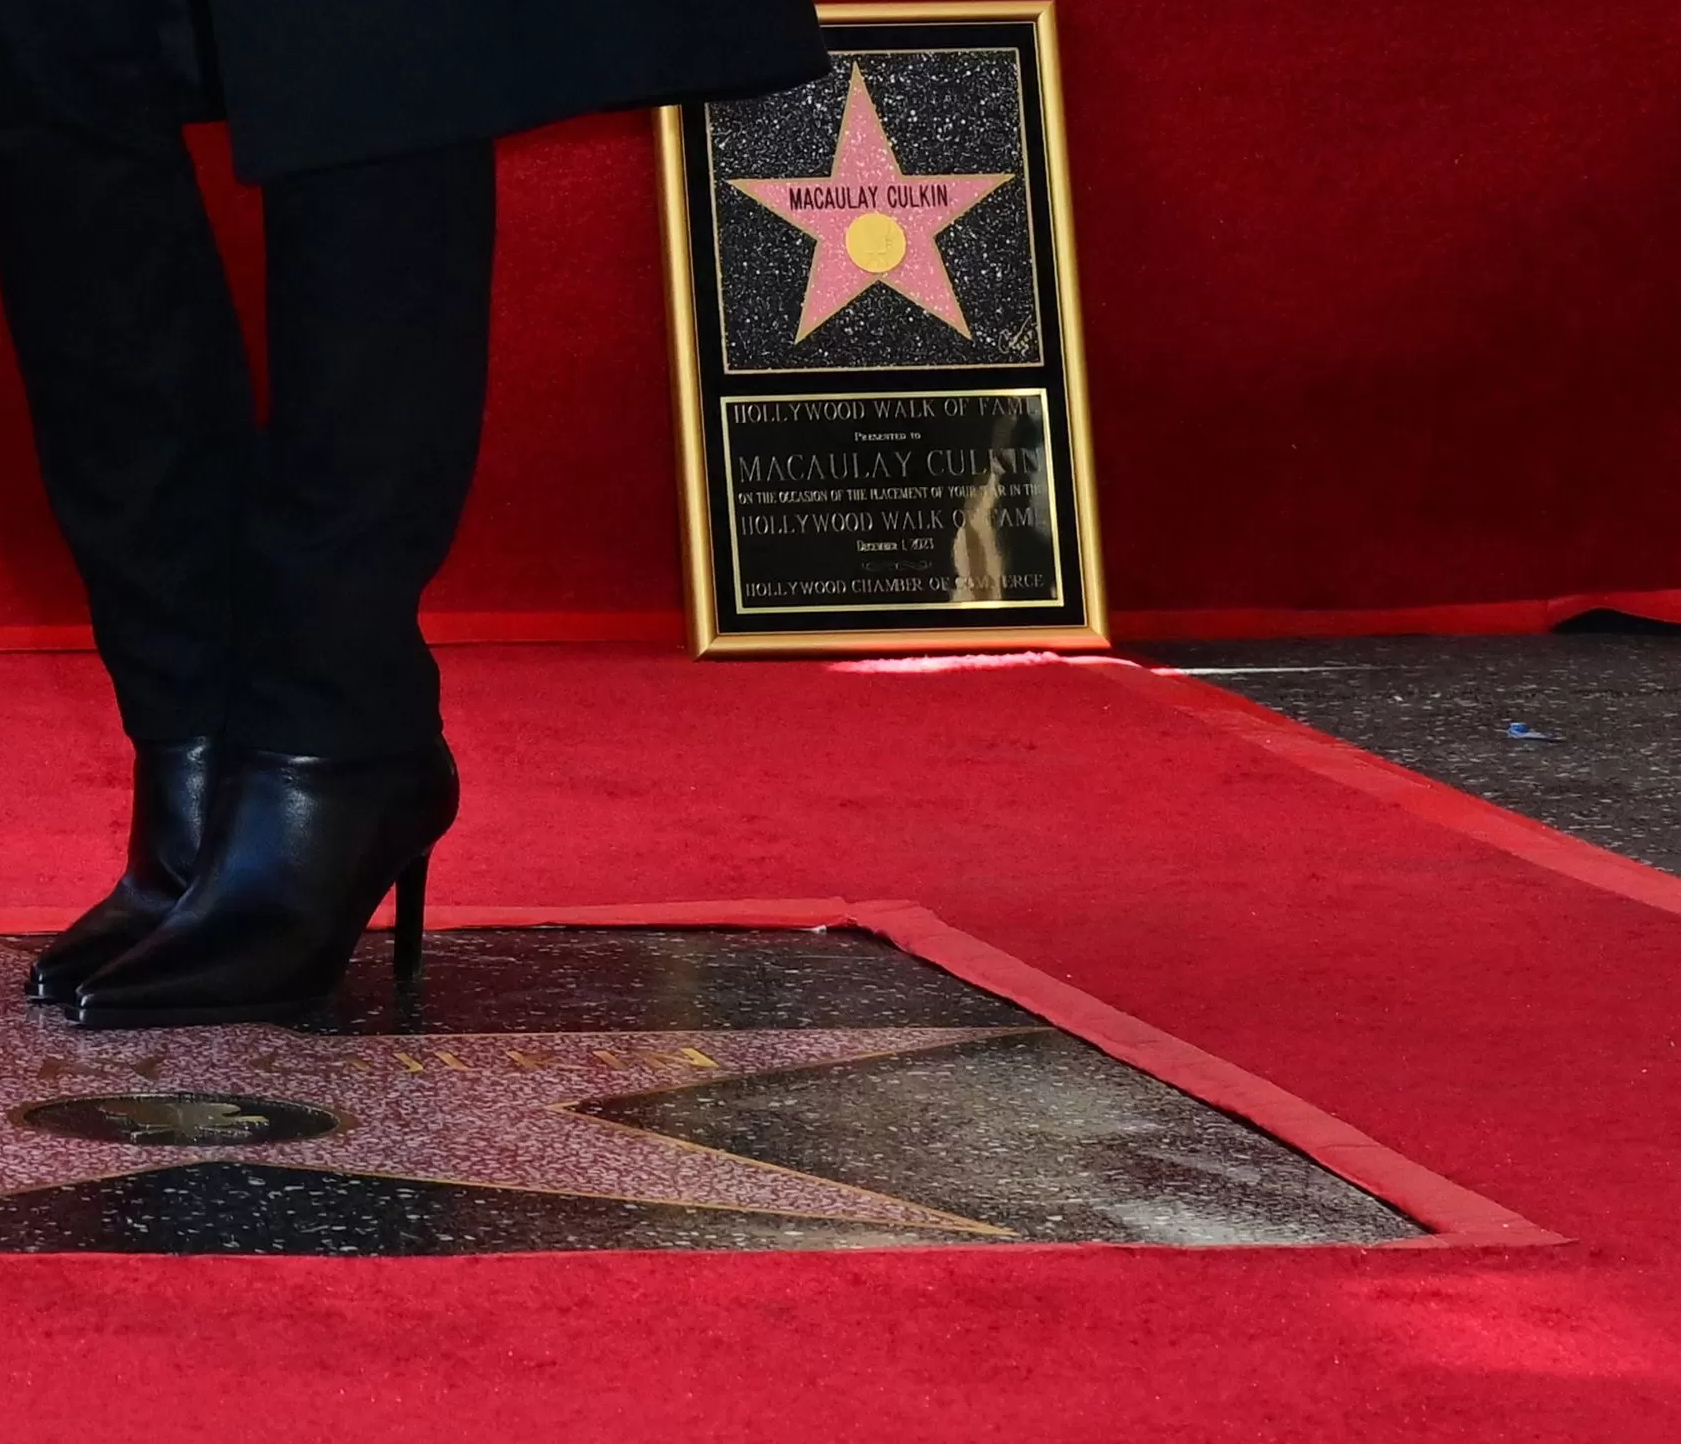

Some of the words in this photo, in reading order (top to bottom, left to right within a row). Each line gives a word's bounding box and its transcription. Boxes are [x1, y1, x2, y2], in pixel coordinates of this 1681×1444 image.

[789, 186, 878, 210] MACAULAY
[887, 184, 949, 208] CULKIN
[734, 401, 865, 423] HOLLYWOOD
[874, 399, 935, 418] WALK
[944, 398, 968, 416] OF
[739, 450, 912, 483] MACAULAY
[927, 447, 1042, 476] CULKIN
[738, 492, 753, 505] ON
[756, 491, 777, 504] THE
[779, 490, 827, 504] OCCASION
[831, 489, 843, 502] OF
[846, 488, 868, 501] THE
[870, 486, 928, 500] PLACEMENT
[931, 485, 944, 499] OF
[1010, 483, 1024, 496] IN
[741, 512, 873, 535] HOLLYWOOD
[881, 509, 943, 530] WALK
[746, 580, 847, 597] HOLLYWOOD
[851, 576, 924, 594] CHAMBER
[929, 576, 950, 591] OF
